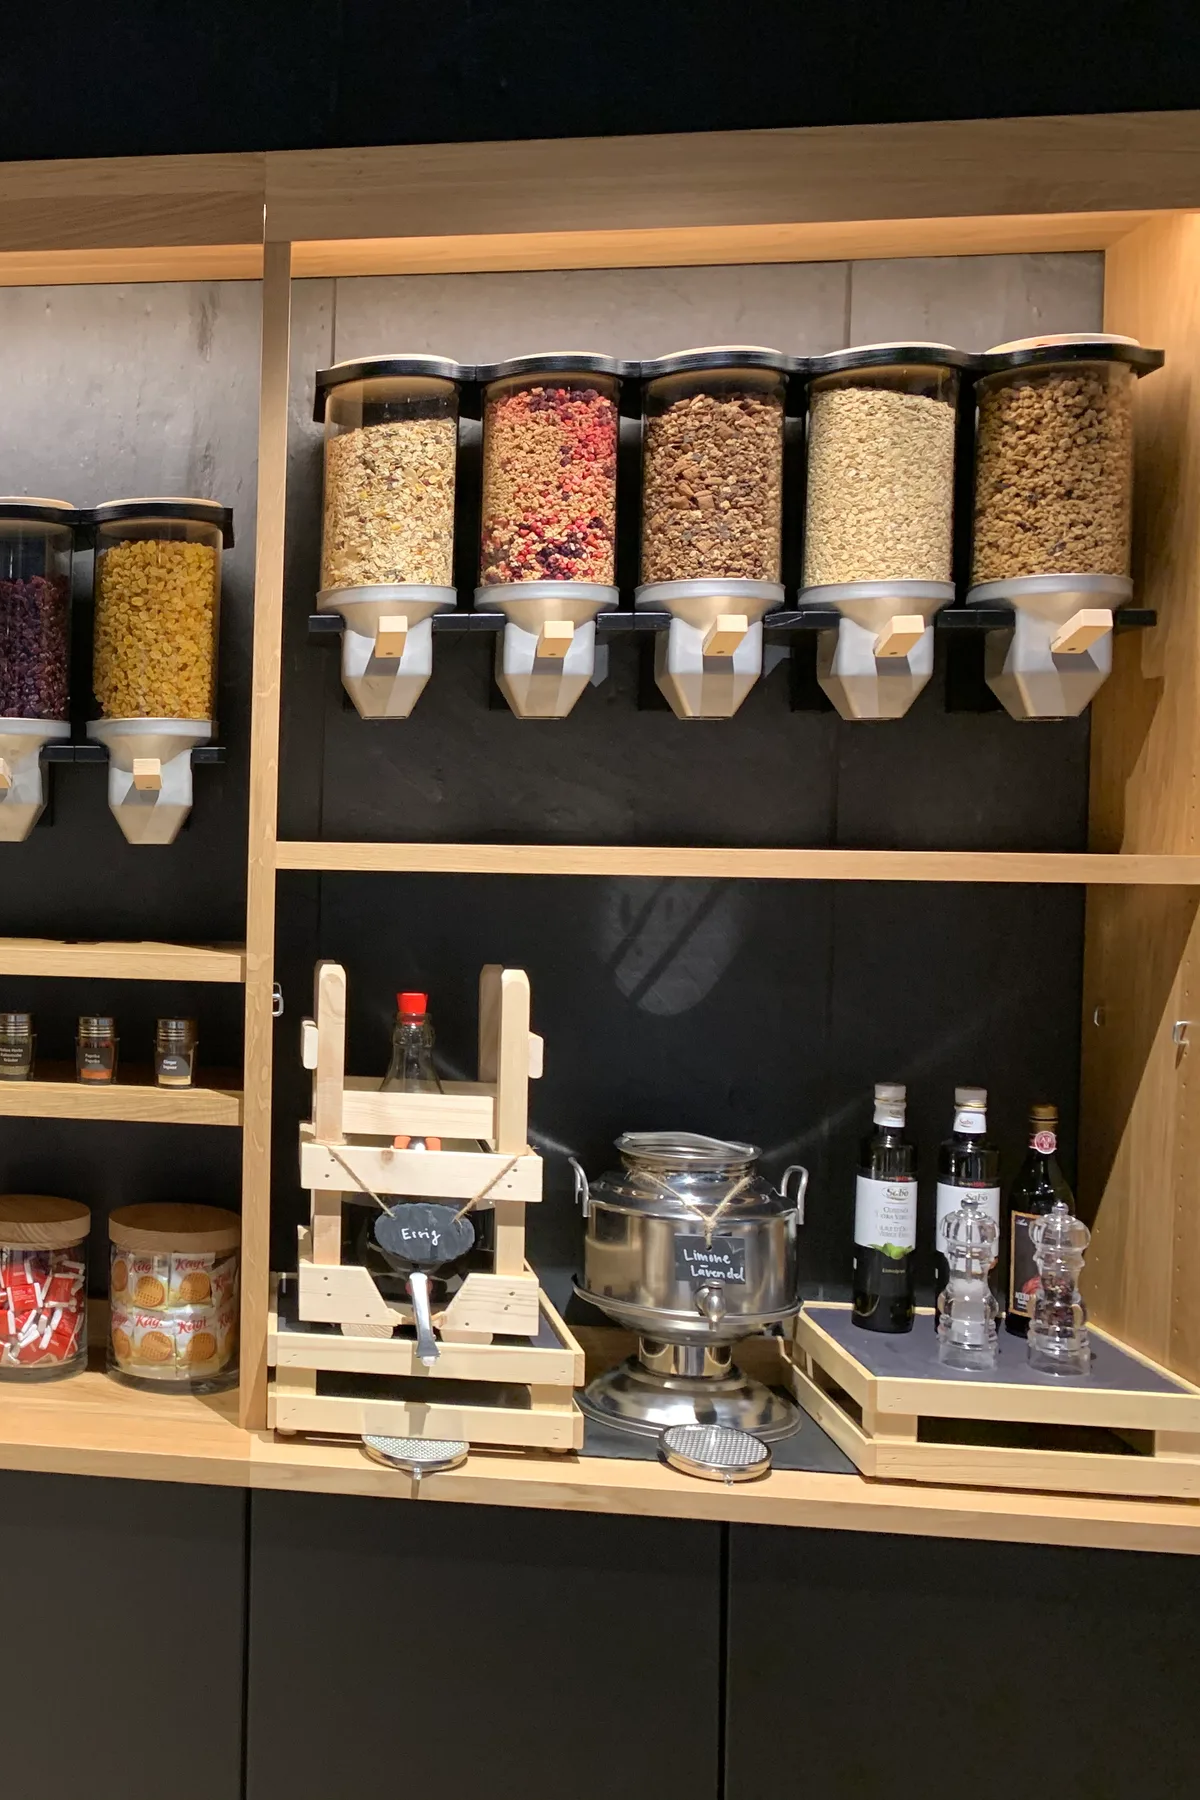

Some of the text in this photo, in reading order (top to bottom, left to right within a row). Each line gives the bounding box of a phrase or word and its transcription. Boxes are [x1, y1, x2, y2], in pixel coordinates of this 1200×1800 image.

[401, 1227, 441, 1246] Essig
[683, 1248, 731, 1264] Limone
[690, 1264, 746, 1282] Lavendel
